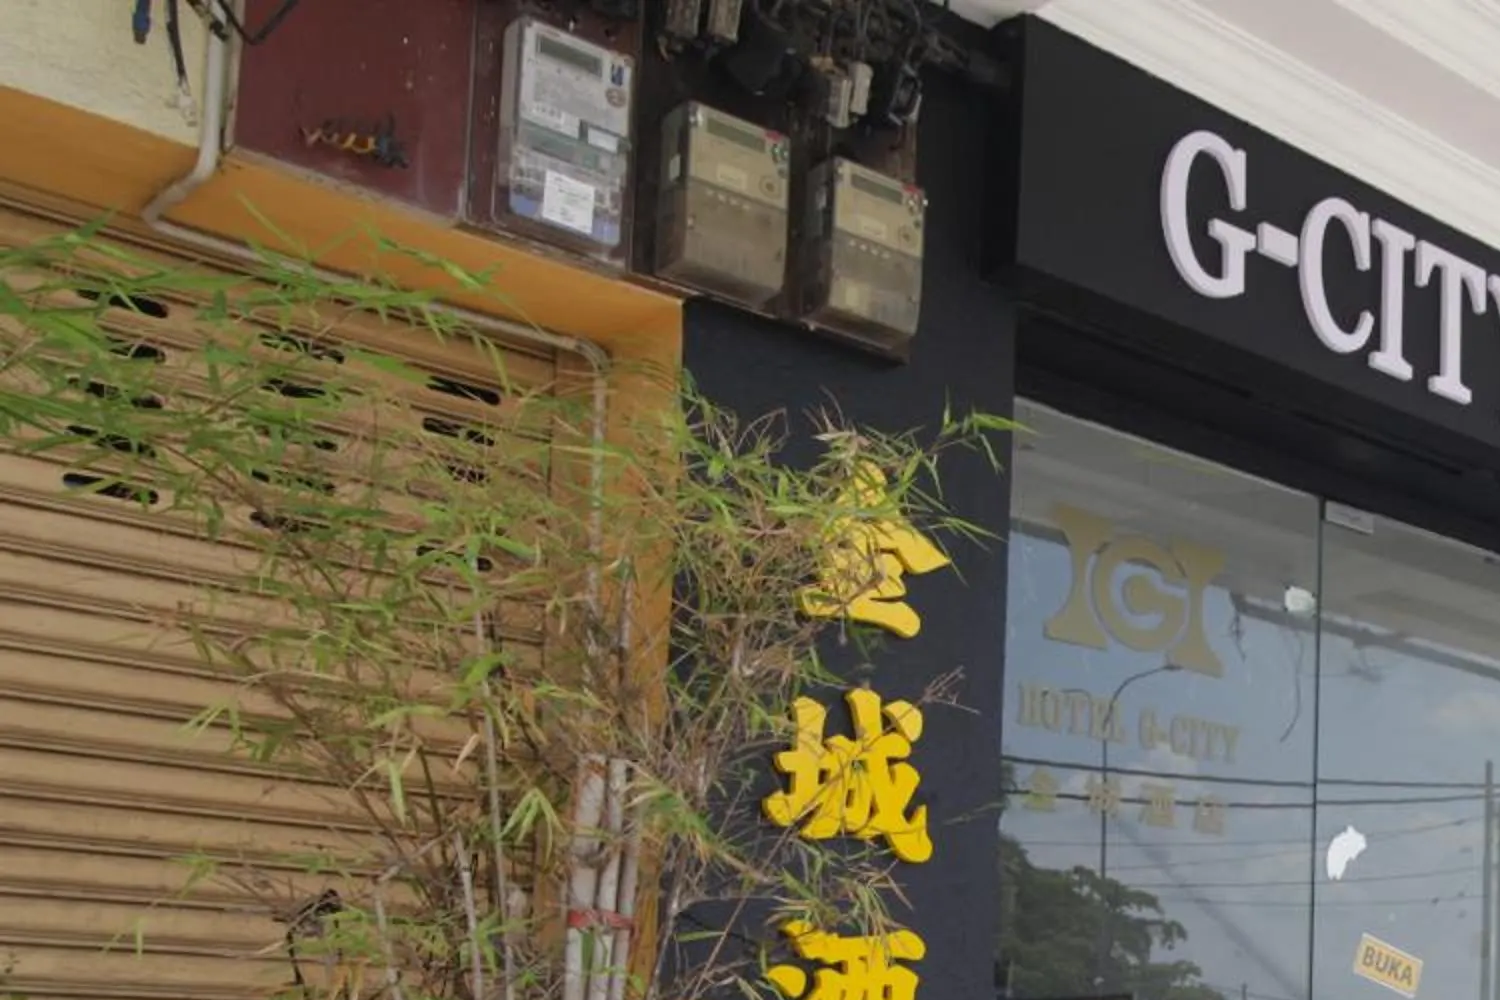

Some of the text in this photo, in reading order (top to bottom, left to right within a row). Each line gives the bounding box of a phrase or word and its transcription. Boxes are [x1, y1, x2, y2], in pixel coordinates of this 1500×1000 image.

[1016, 680, 1241, 765] HOTEL G-CITY
[1361, 945, 1415, 988] BUKA
